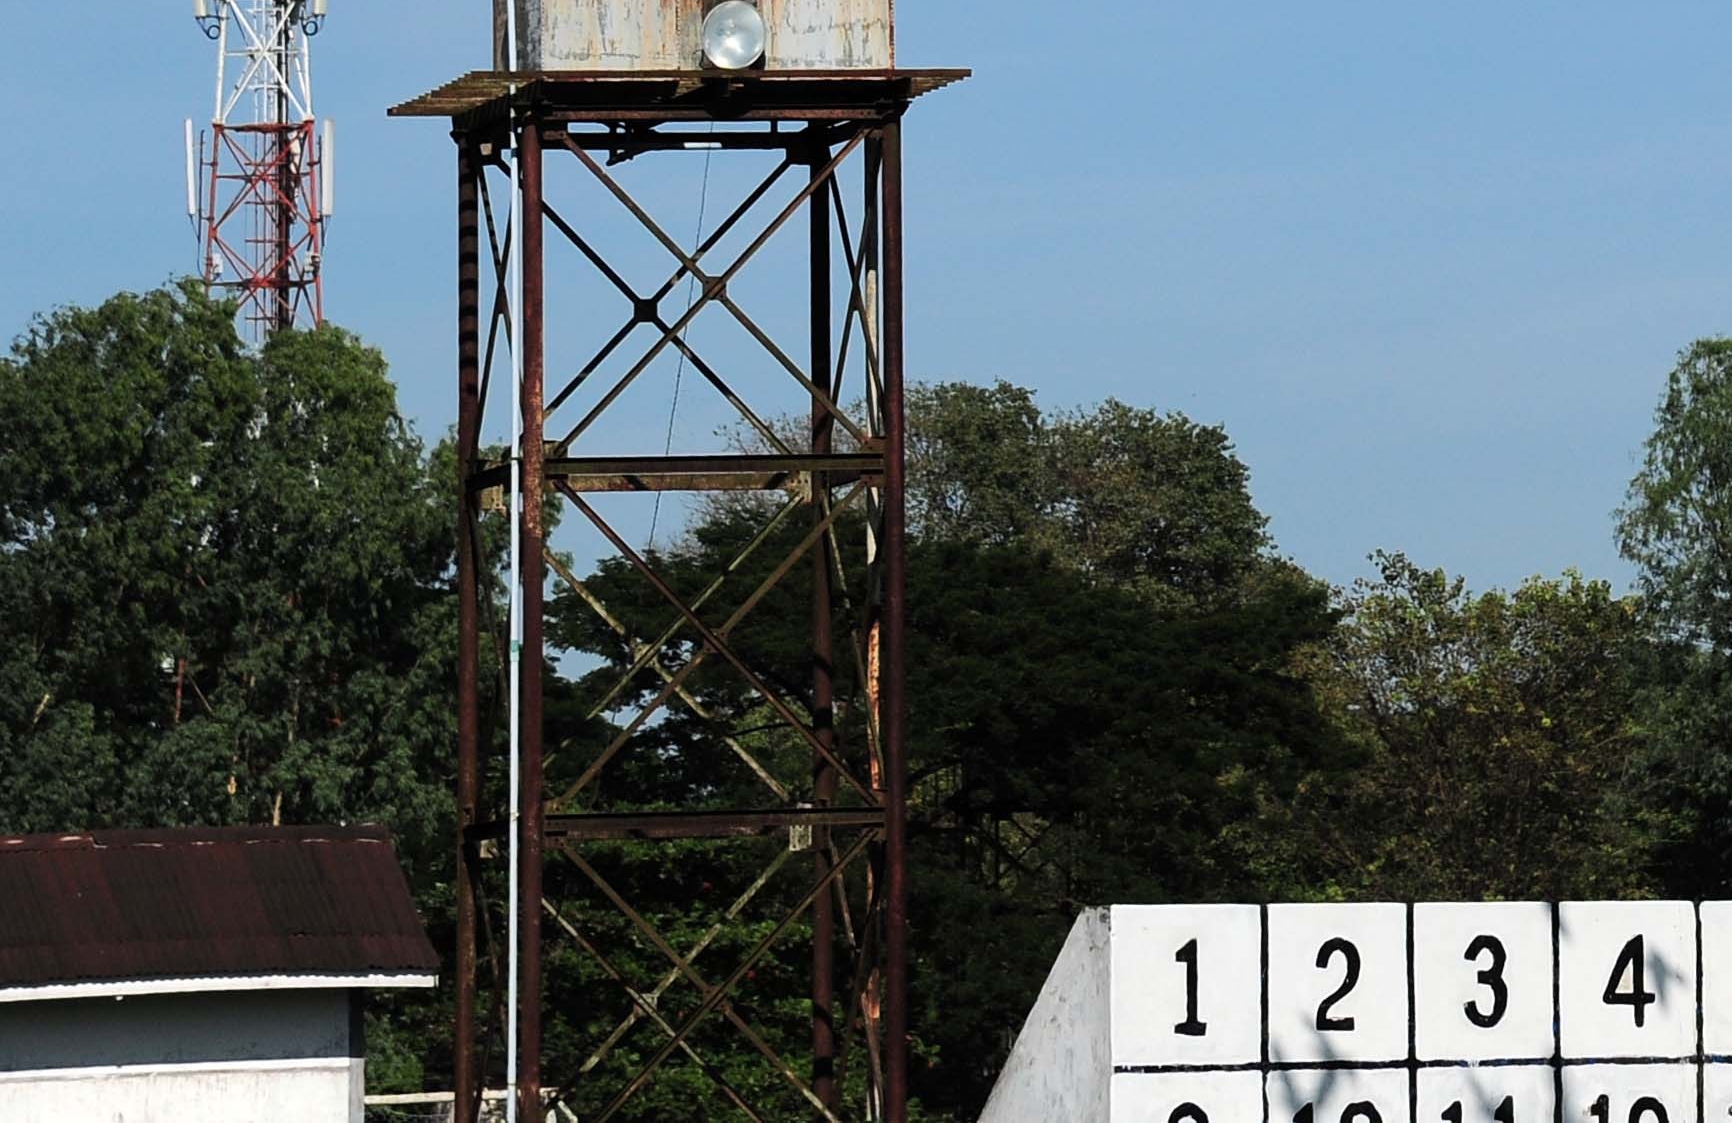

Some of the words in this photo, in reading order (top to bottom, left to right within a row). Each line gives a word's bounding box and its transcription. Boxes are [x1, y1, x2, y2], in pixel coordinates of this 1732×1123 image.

[1174, 938, 1207, 1037] 1
[1315, 937, 1361, 1032] 2
[1463, 934, 1508, 1029] 3
[1602, 933, 1656, 1028] 4
